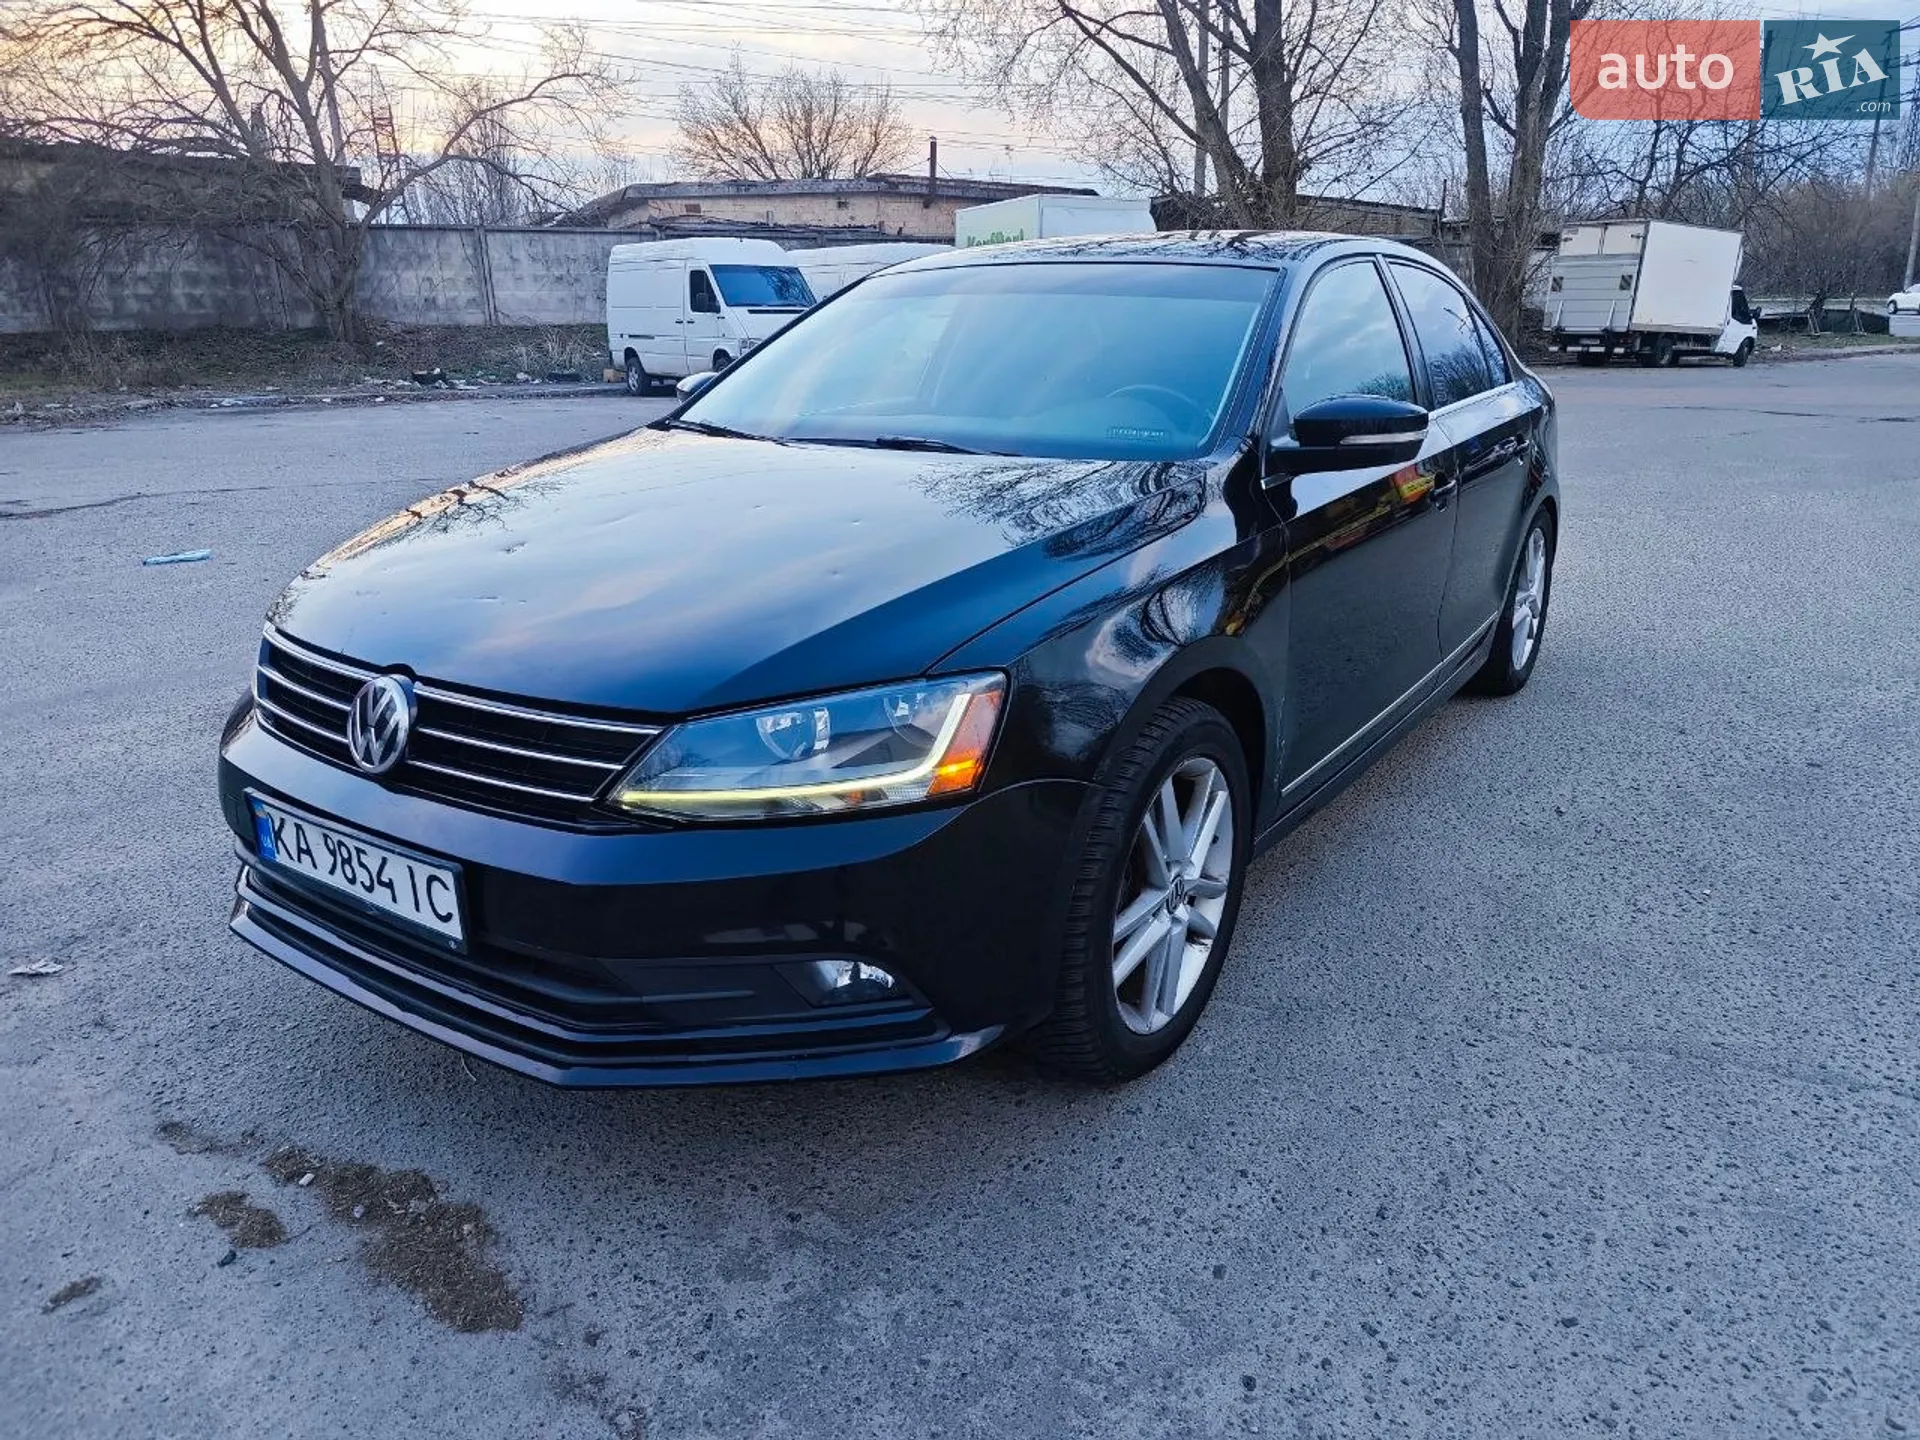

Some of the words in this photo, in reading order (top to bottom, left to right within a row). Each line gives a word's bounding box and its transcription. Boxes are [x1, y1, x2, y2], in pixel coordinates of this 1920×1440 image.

[266, 811, 318, 870] KA
[323, 832, 398, 905] 9854
[407, 864, 454, 924] IC
